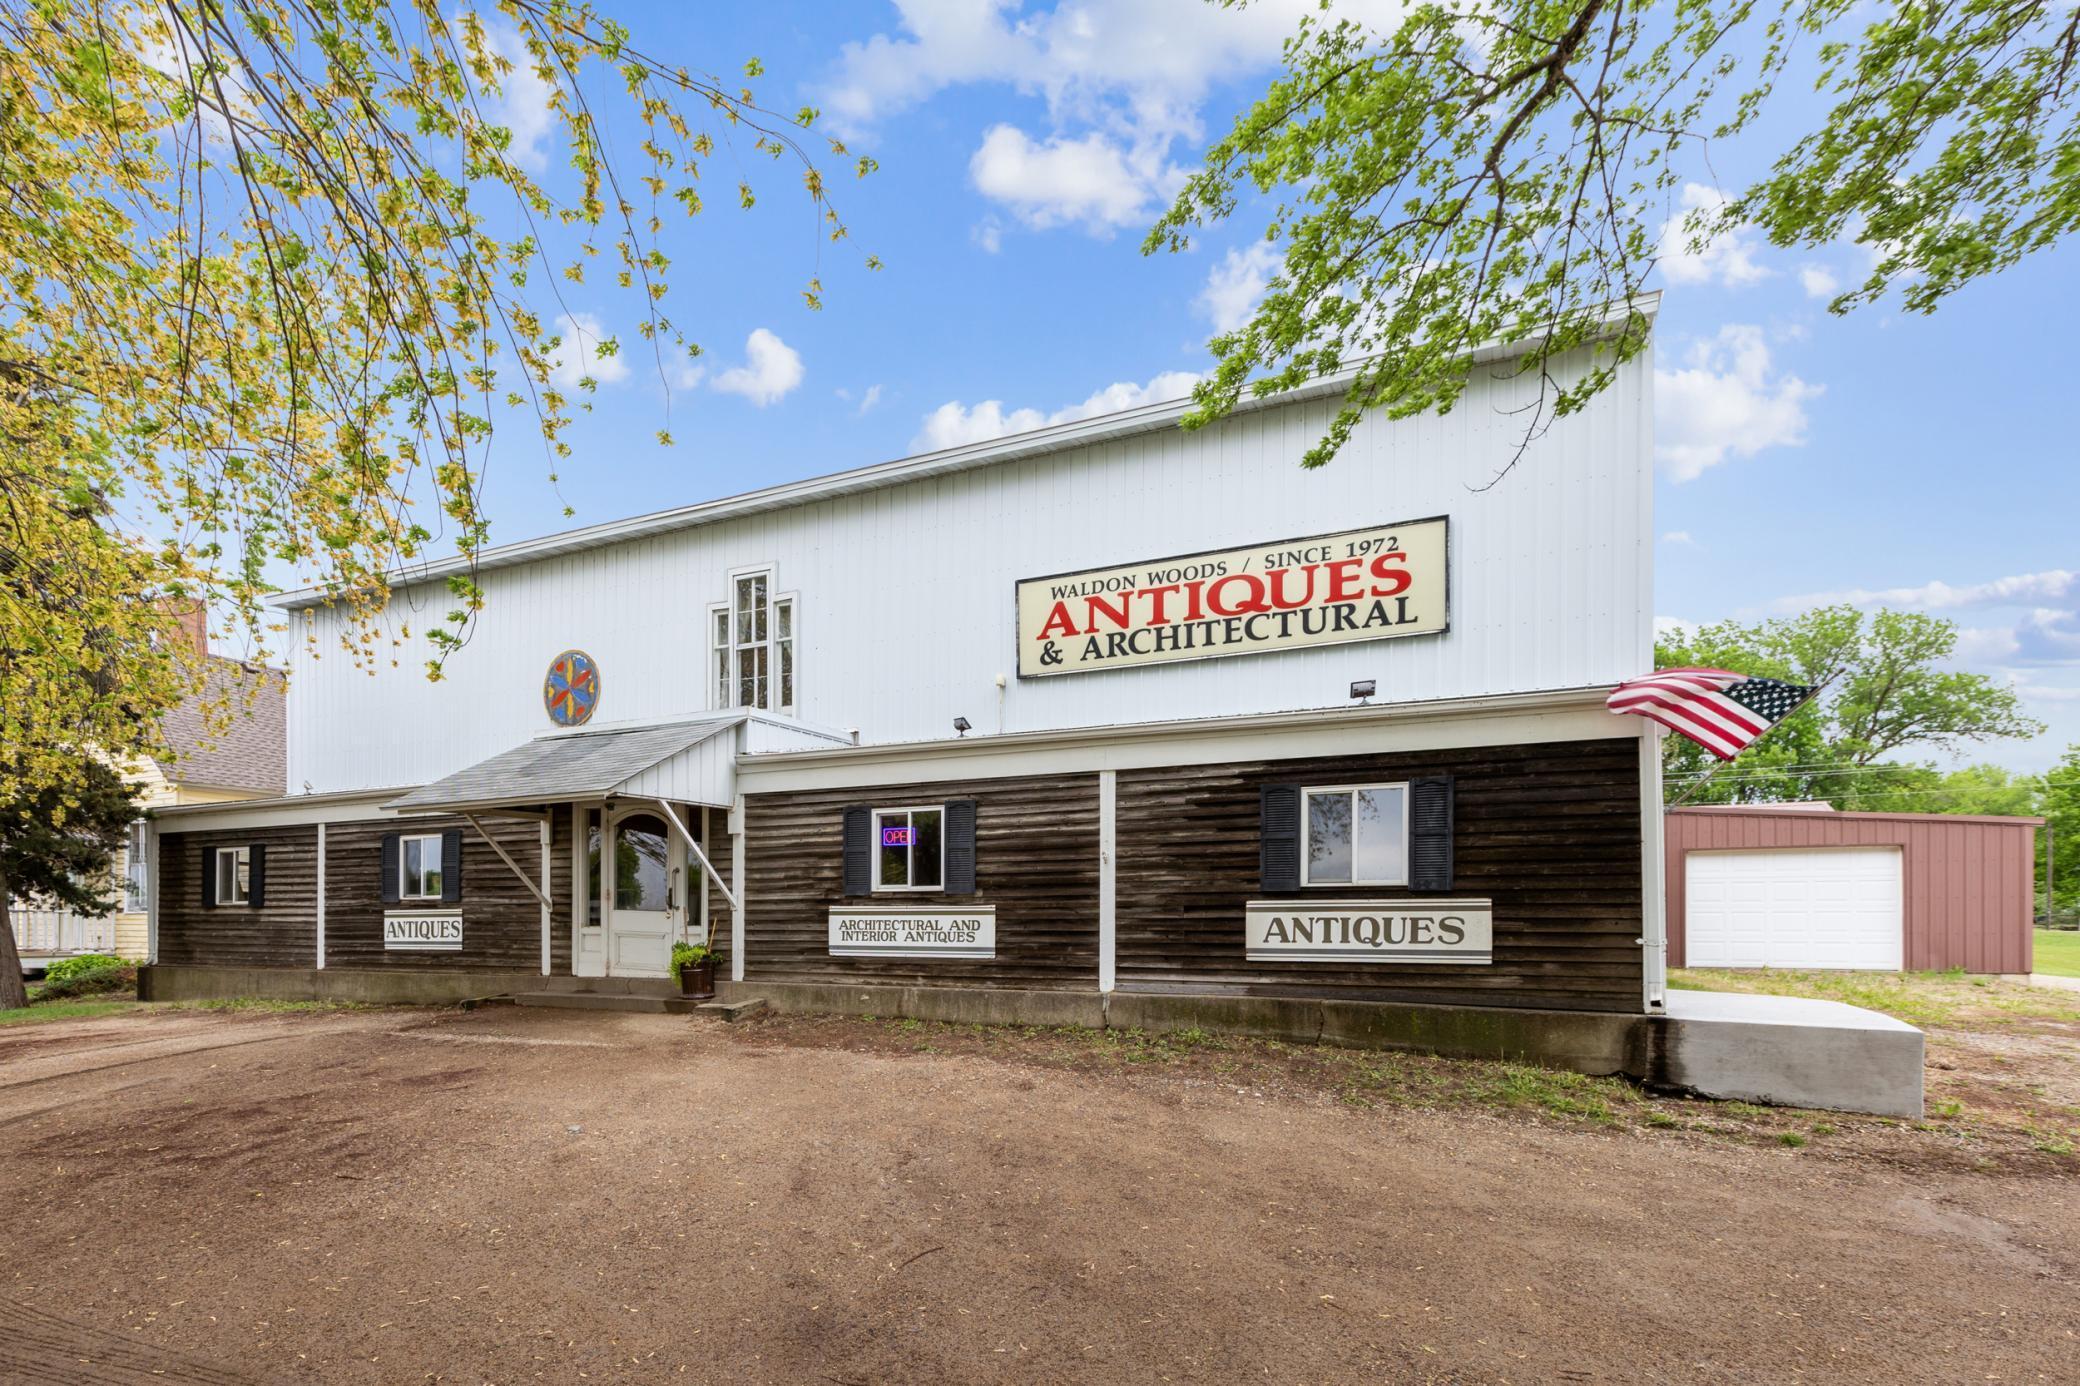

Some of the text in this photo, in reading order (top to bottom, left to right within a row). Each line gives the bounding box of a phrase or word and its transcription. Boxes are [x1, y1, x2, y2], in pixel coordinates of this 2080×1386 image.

[1051, 574, 1137, 600] WALDON
[1147, 560, 1228, 586] WOODS
[1265, 545, 1333, 570] SINCE
[1346, 536, 1400, 558] 1972
[1036, 552, 1413, 641] ANTIQUES
[1039, 596, 1419, 666] & ARCHITECTURAL
[386, 920, 461, 939] ANTIQUES
[839, 919, 981, 931] ARCHITECTURAL AND
[841, 931, 976, 943] INTERIOR ANTIQUES
[1263, 916, 1465, 947] ANTIQUES
